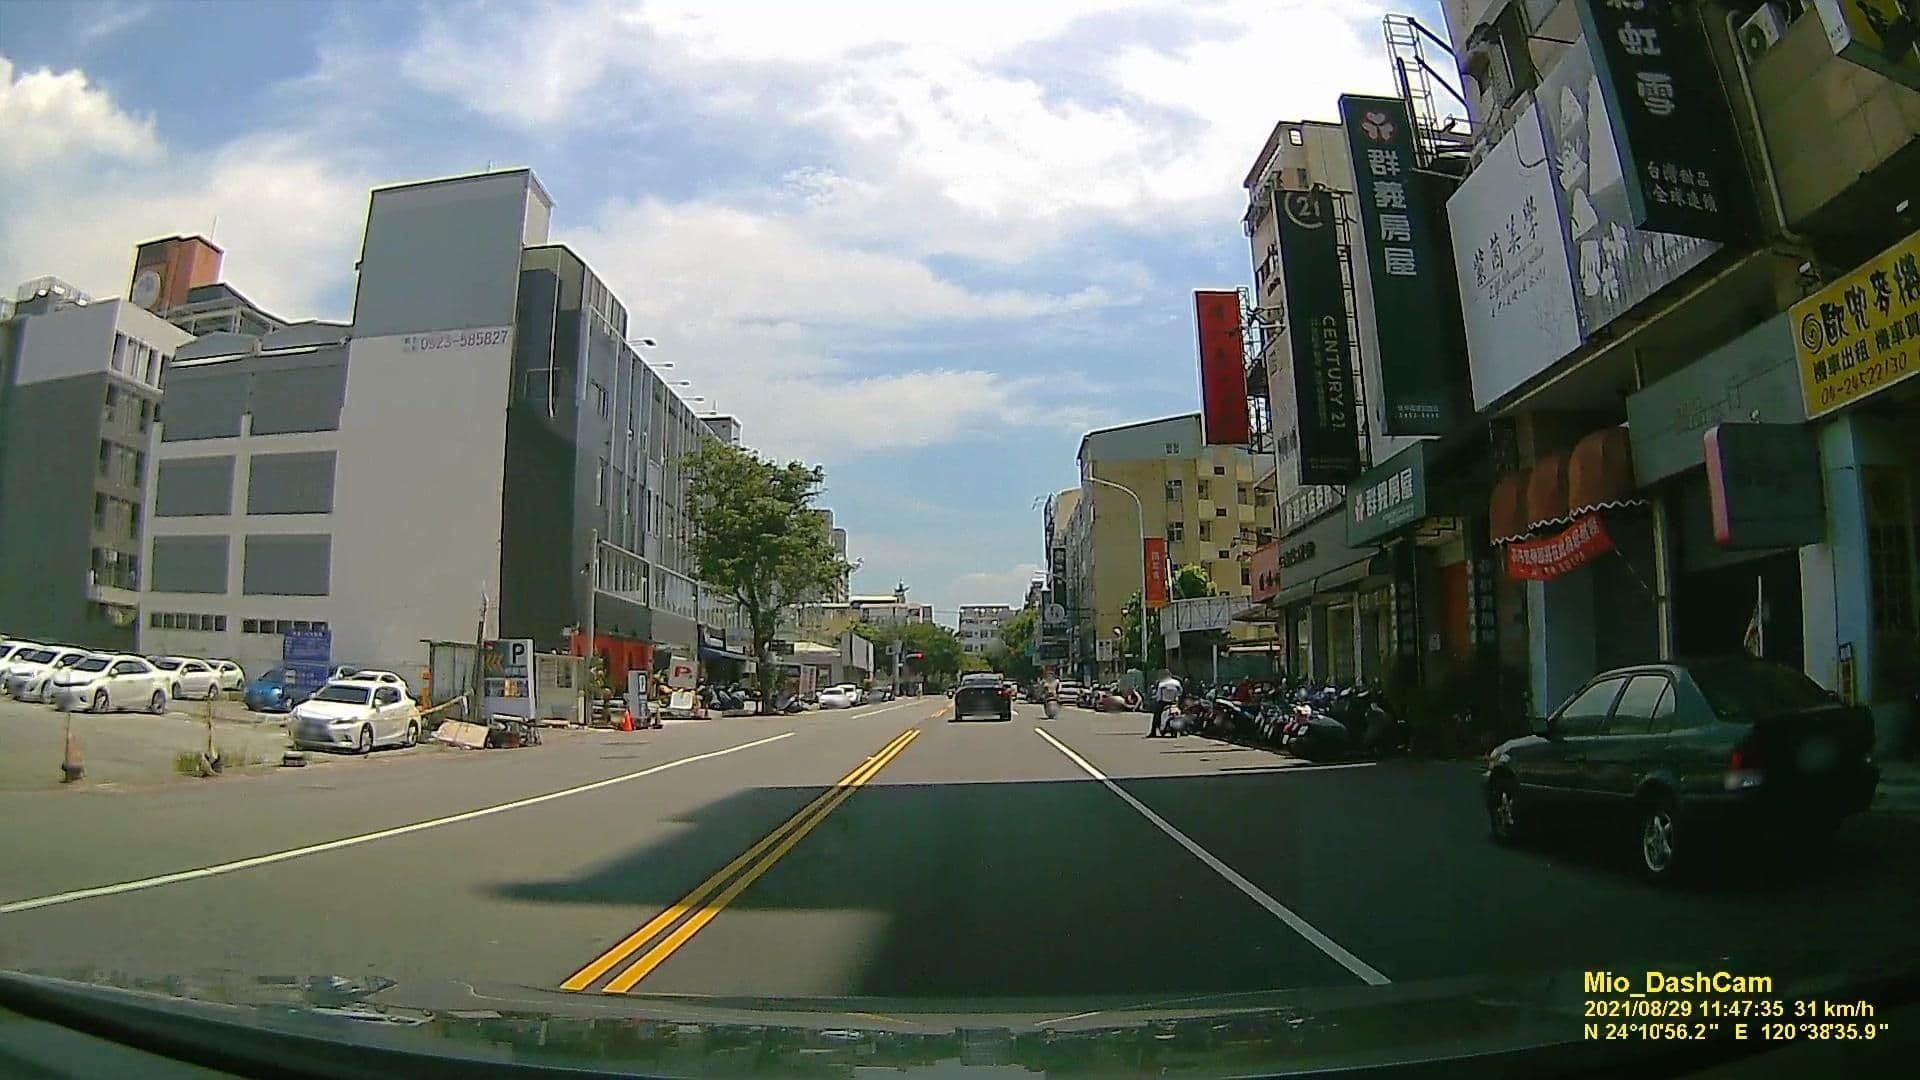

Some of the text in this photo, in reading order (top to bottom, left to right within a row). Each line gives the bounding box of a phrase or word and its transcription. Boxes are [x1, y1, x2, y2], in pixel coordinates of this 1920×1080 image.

[1367, 148, 1418, 277] 群義房屋
[1322, 315, 1345, 407] CENTURY
[1813, 339, 1870, 384] 機車出租
[512, 643, 525, 665] P
